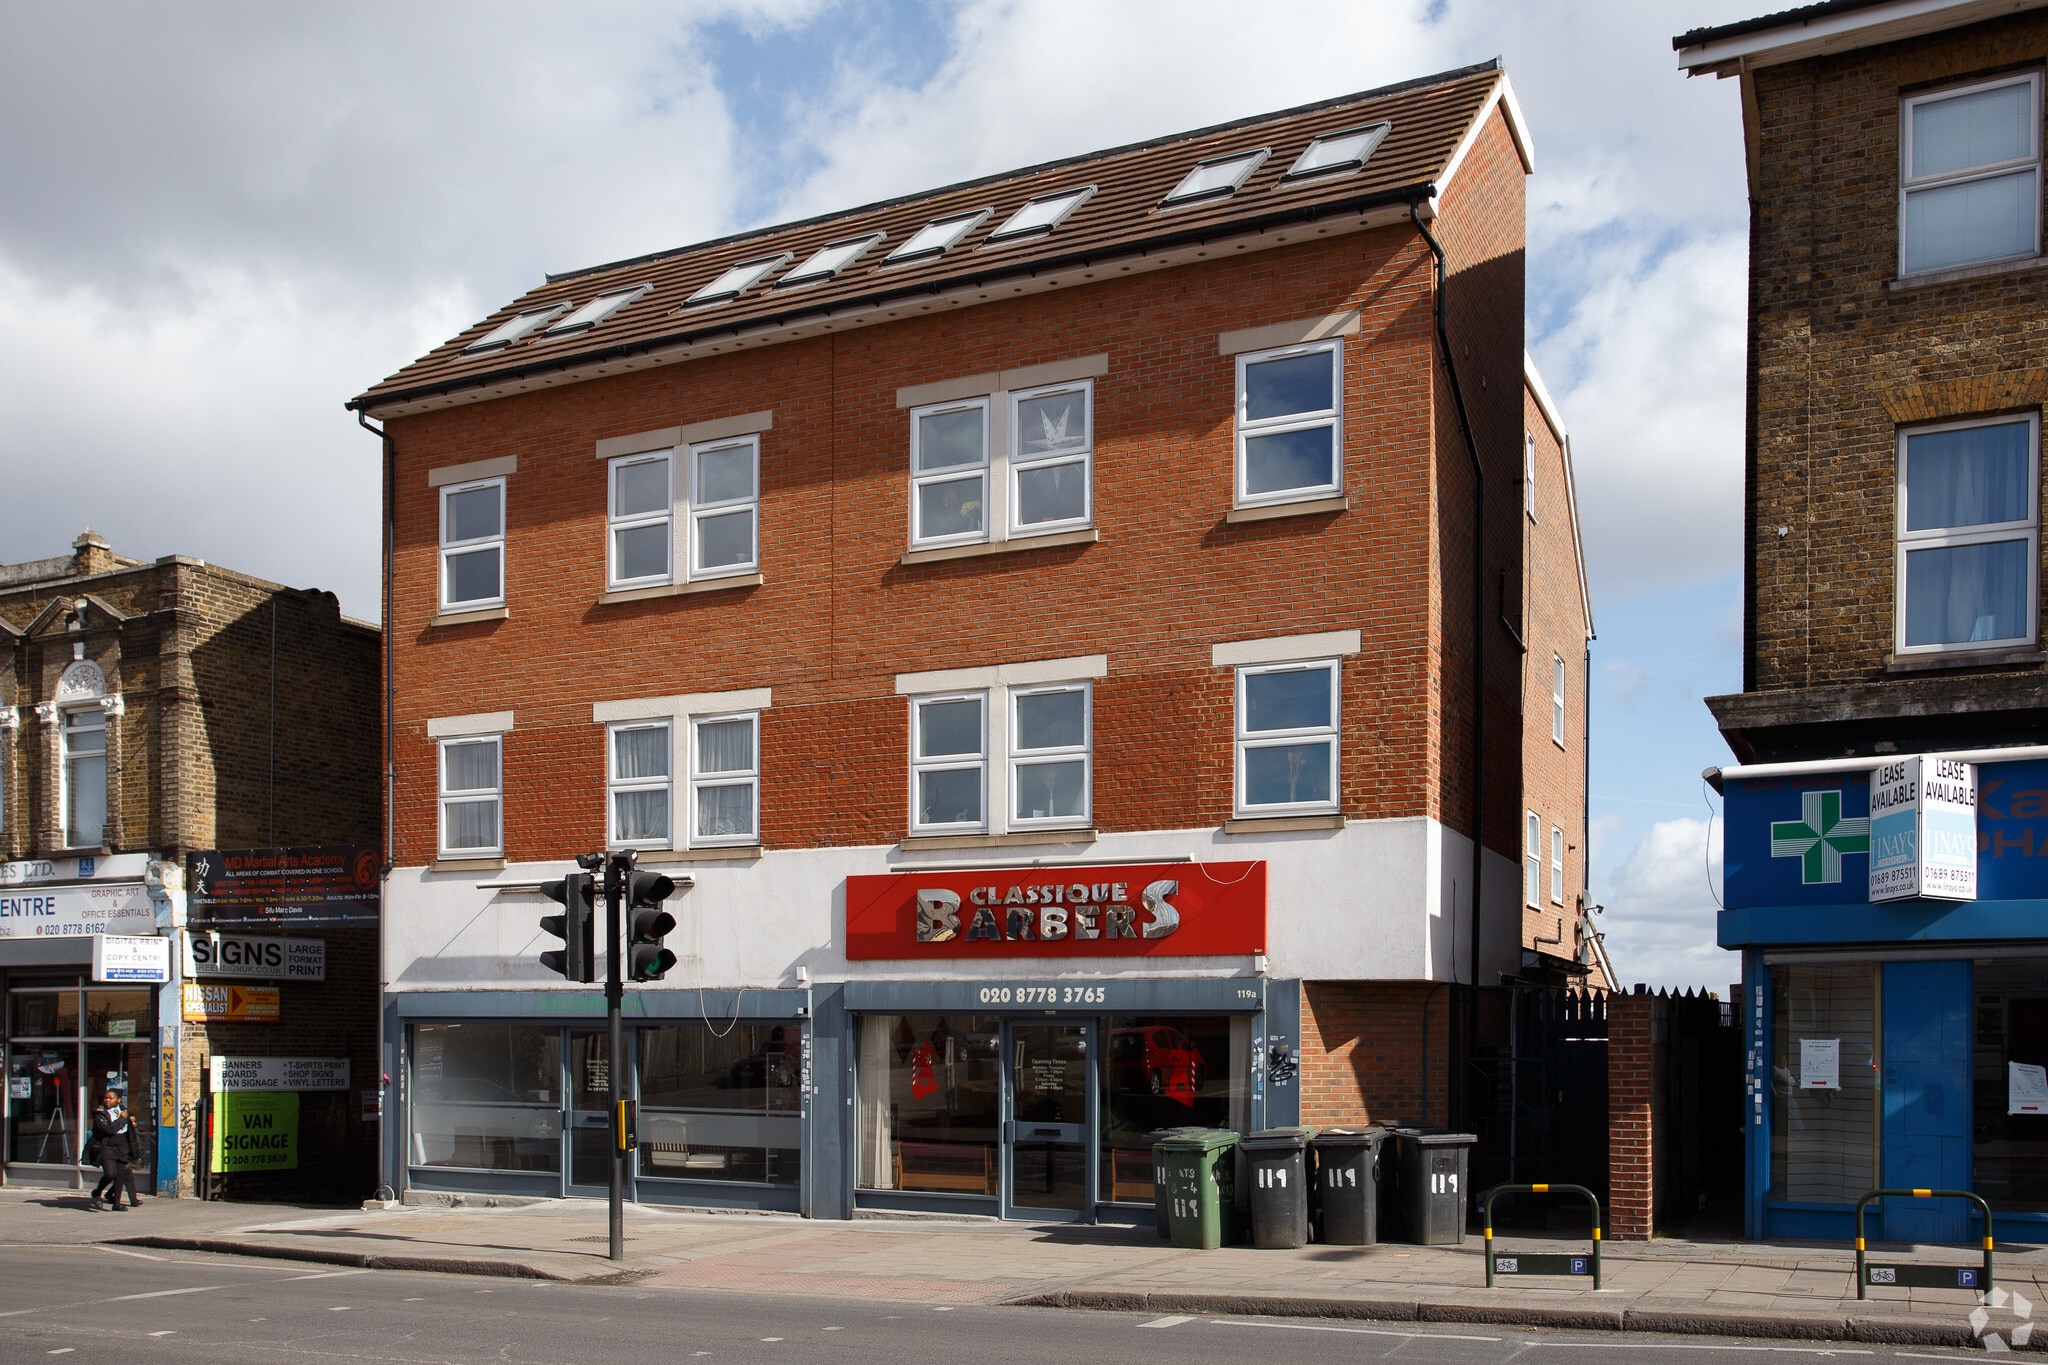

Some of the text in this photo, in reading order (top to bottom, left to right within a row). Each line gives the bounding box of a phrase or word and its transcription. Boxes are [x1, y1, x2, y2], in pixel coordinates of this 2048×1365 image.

[1879, 762, 1905, 786] LEASE
[1936, 758, 1965, 781] LEASE
[1871, 782, 1915, 812] AVAILABLE
[1925, 781, 1975, 806] AVAILABLE
[1872, 830, 1915, 869] LINAYS
[1926, 829, 1974, 866] LINAYS
[225, 853, 346, 869] MD Martial Arts Academy
[24, 861, 56, 878] LTD.
[1871, 866, 1916, 886] 01689 875511
[1925, 866, 1975, 883] 01689 875511
[125, 887, 140, 897] ART
[969, 882, 1129, 905] CLASSIQUE
[1871, 881, 1915, 896] www.linays.co.uk
[1926, 882, 1973, 893] www.linays.co.uk
[112, 900, 118, 908] &
[265, 906, 303, 914] Sifu Marc Davis
[916, 879, 1180, 942] BARBERS
[81, 908, 151, 920] OFFICE ESSENTIALS
[45, 922, 105, 936] 020 8778 6162
[105, 936, 137, 945] DIGITAL
[192, 938, 282, 967] SIGNS
[288, 944, 323, 955] LARGE
[288, 954, 323, 965] FORMAT
[288, 965, 323, 976] PRINT
[185, 986, 229, 1002] NISSAN
[979, 987, 1106, 1003] 020 8778 3765
[1237, 989, 1257, 999] 119a
[185, 1002, 229, 1014] SPECIALIST
[537, 996, 569, 1012] 020
[221, 1061, 263, 1069] BANNERS
[288, 1061, 346, 1070] T-SHIRTS PRINT
[162, 1053, 175, 1107] NISSAN
[221, 1070, 258, 1078] BOARDS
[288, 1070, 335, 1078] SHOP SIGNS
[221, 1078, 279, 1087] VAN SIGNAGE
[288, 1078, 346, 1087] VINYL LETTERS
[242, 1113, 273, 1129] VAN
[223, 1133, 289, 1151] SIGNAGE
[232, 1155, 249, 1165] 208
[251, 1154, 266, 1164] 778
[267, 1153, 288, 1164] 5628
[1258, 1168, 1287, 1189] 119
[1328, 1168, 1356, 1188] 119
[1431, 1173, 1458, 1194] 119
[1174, 1198, 1198, 1218] 119
[1574, 1260, 1583, 1272] P
[1962, 1272, 1972, 1284] P
